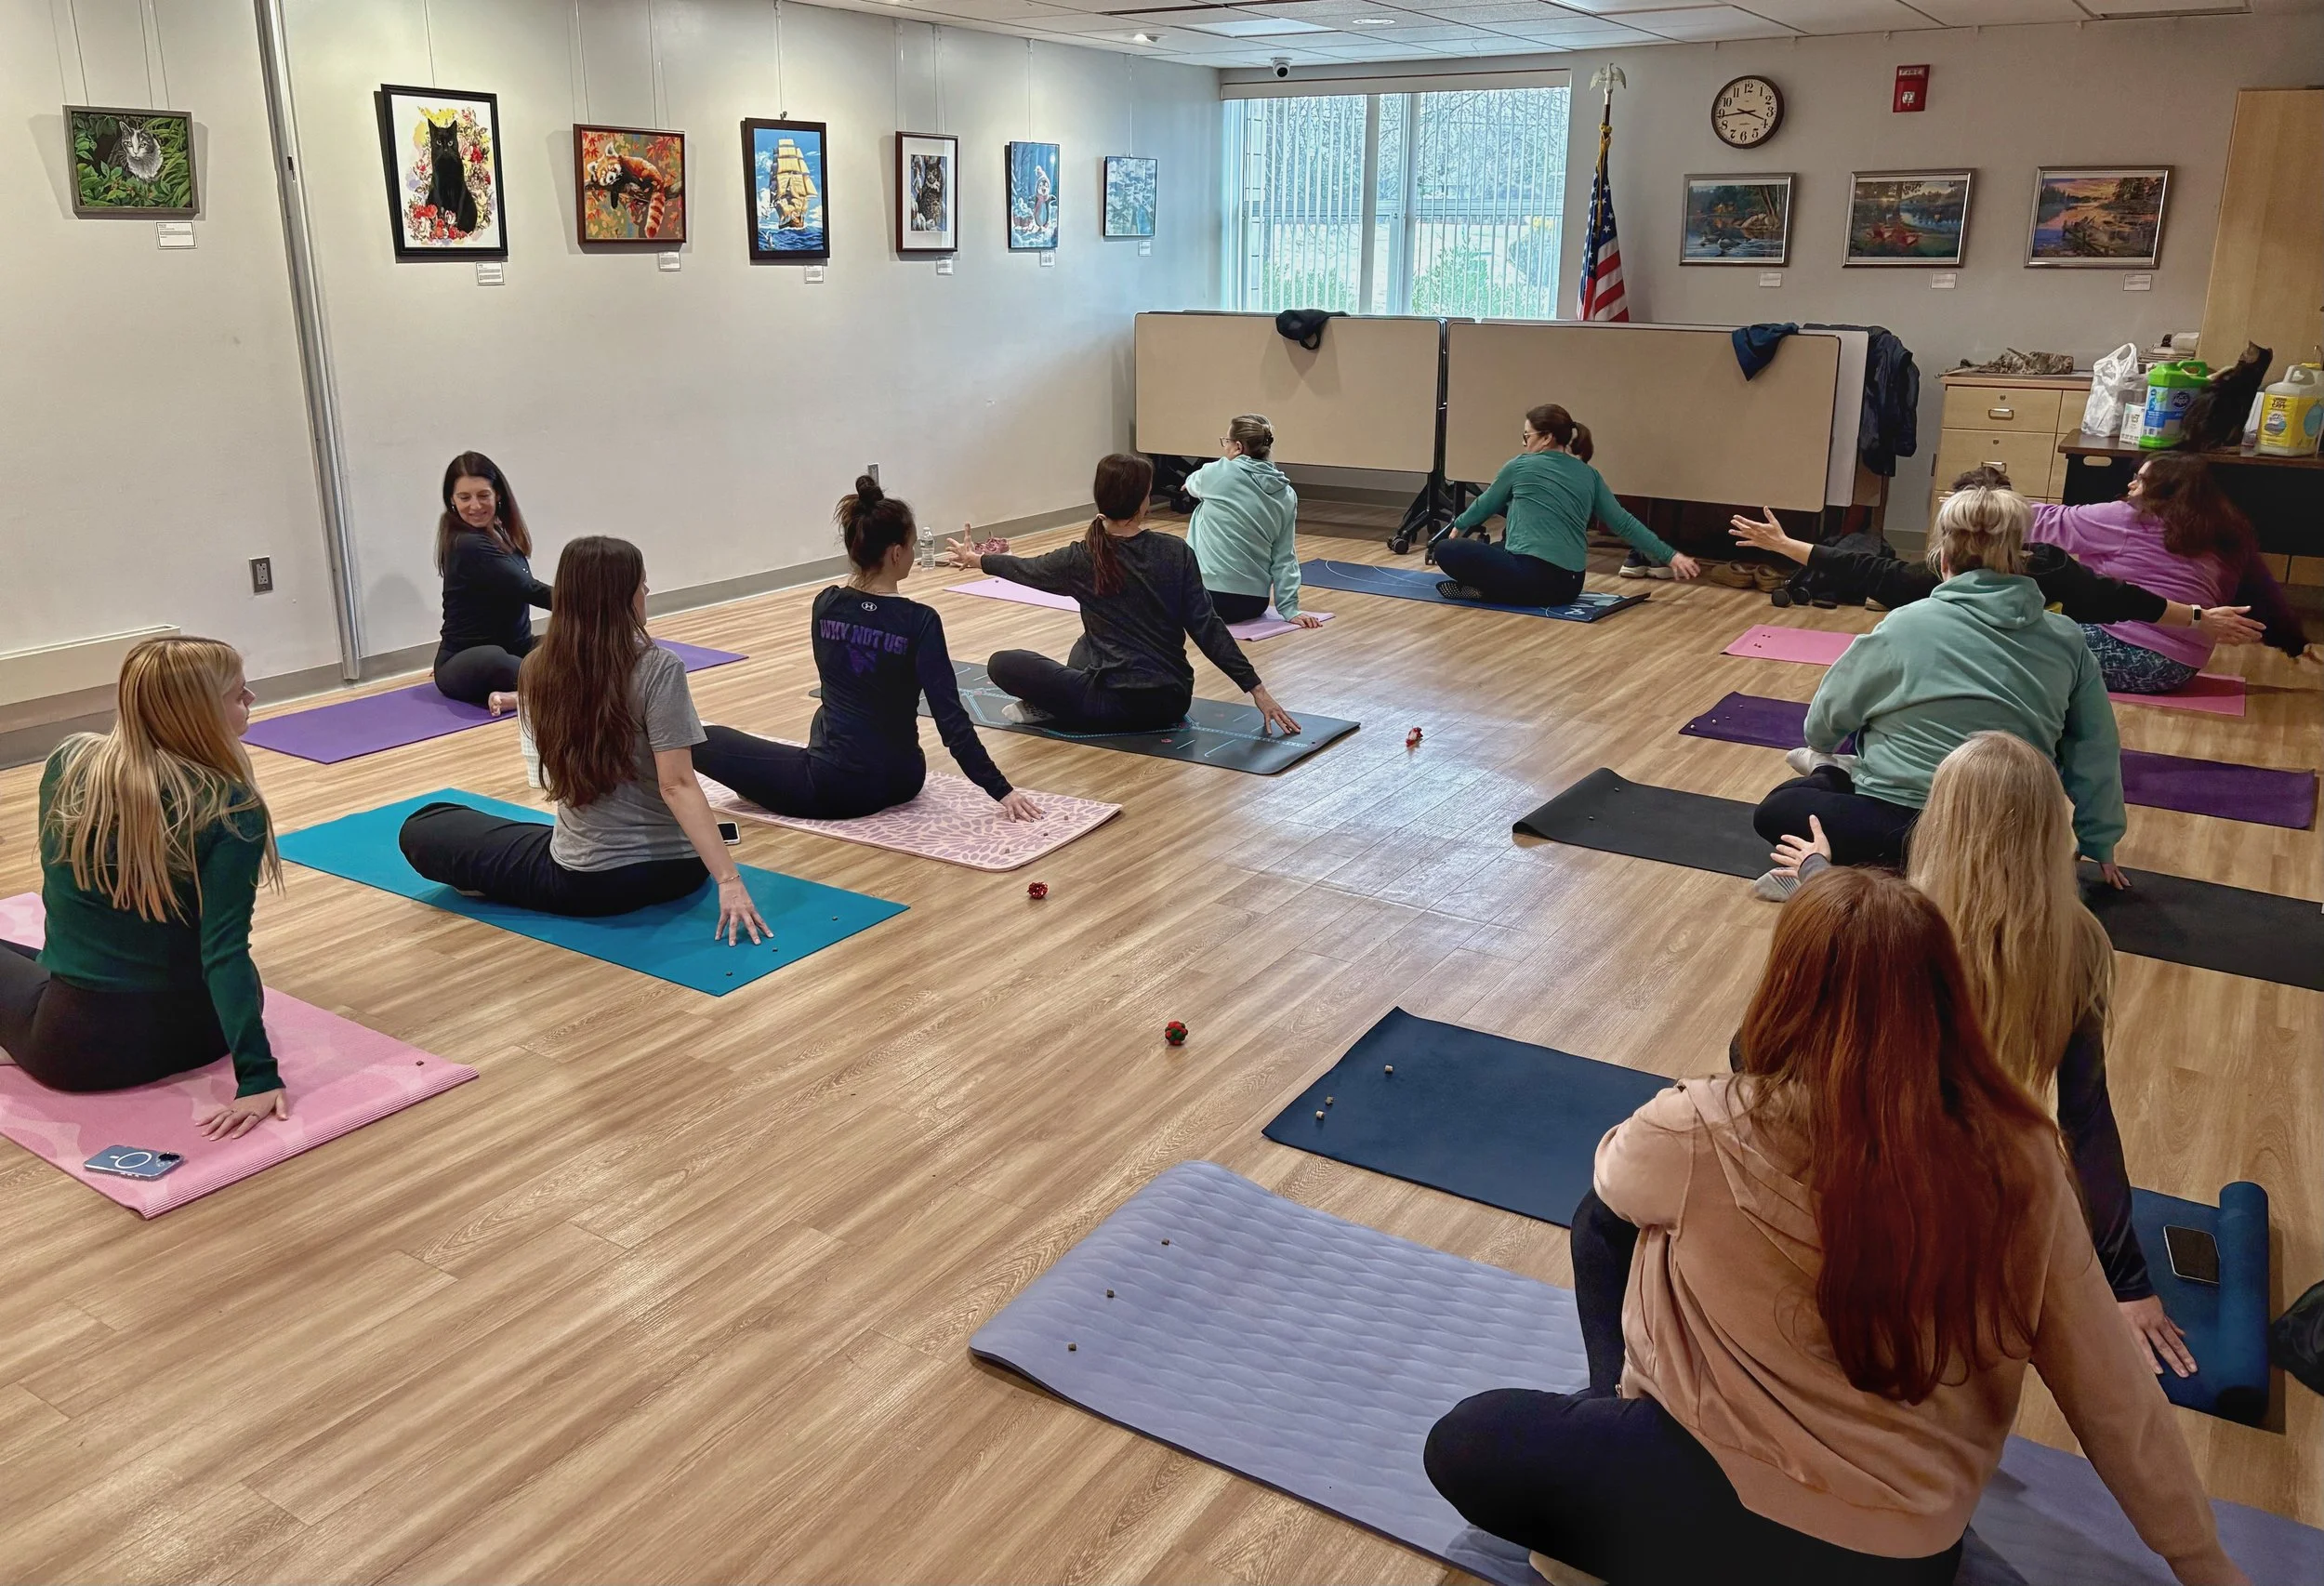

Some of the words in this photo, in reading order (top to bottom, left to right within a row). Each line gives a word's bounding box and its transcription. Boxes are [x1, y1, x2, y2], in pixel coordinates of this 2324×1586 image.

[1733, 86, 1740, 99] 11
[1744, 83, 1754, 94] 12
[1759, 86, 1763, 97] 1
[1723, 97, 1733, 108] 10
[1764, 95, 1772, 105] 2
[1718, 108, 1725, 119] 9
[1766, 106, 1774, 117] 3
[1721, 119, 1728, 130] 8
[1761, 118, 1768, 128] 4
[1730, 129, 1736, 139] 7
[1740, 130, 1747, 141] 6
[1751, 128, 1759, 139] 5
[819, 619, 851, 641] WHY
[851, 624, 884, 649] NOT
